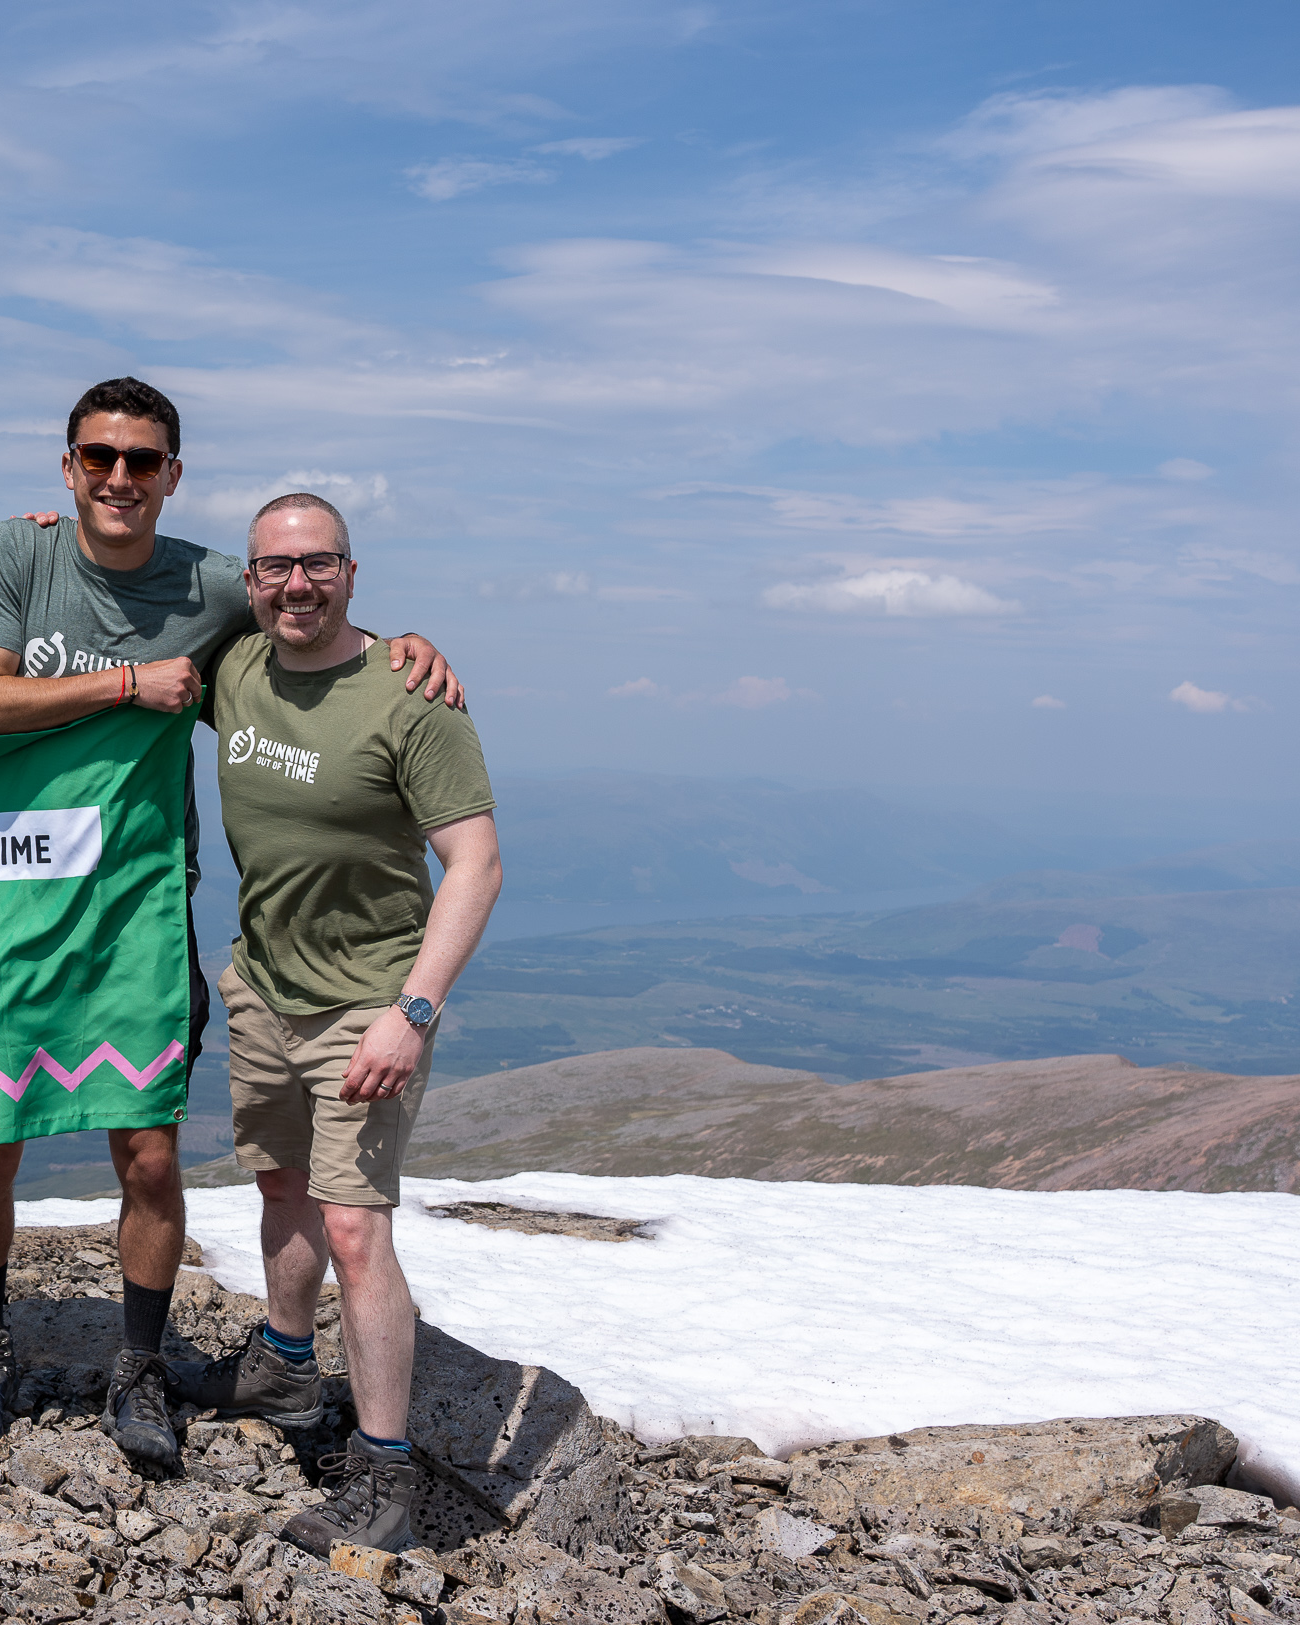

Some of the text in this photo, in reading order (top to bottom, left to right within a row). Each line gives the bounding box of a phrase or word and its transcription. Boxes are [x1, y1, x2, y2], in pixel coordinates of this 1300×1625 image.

[256, 737, 321, 768] RUNNING
[255, 756, 317, 784] OUT OF TIME
